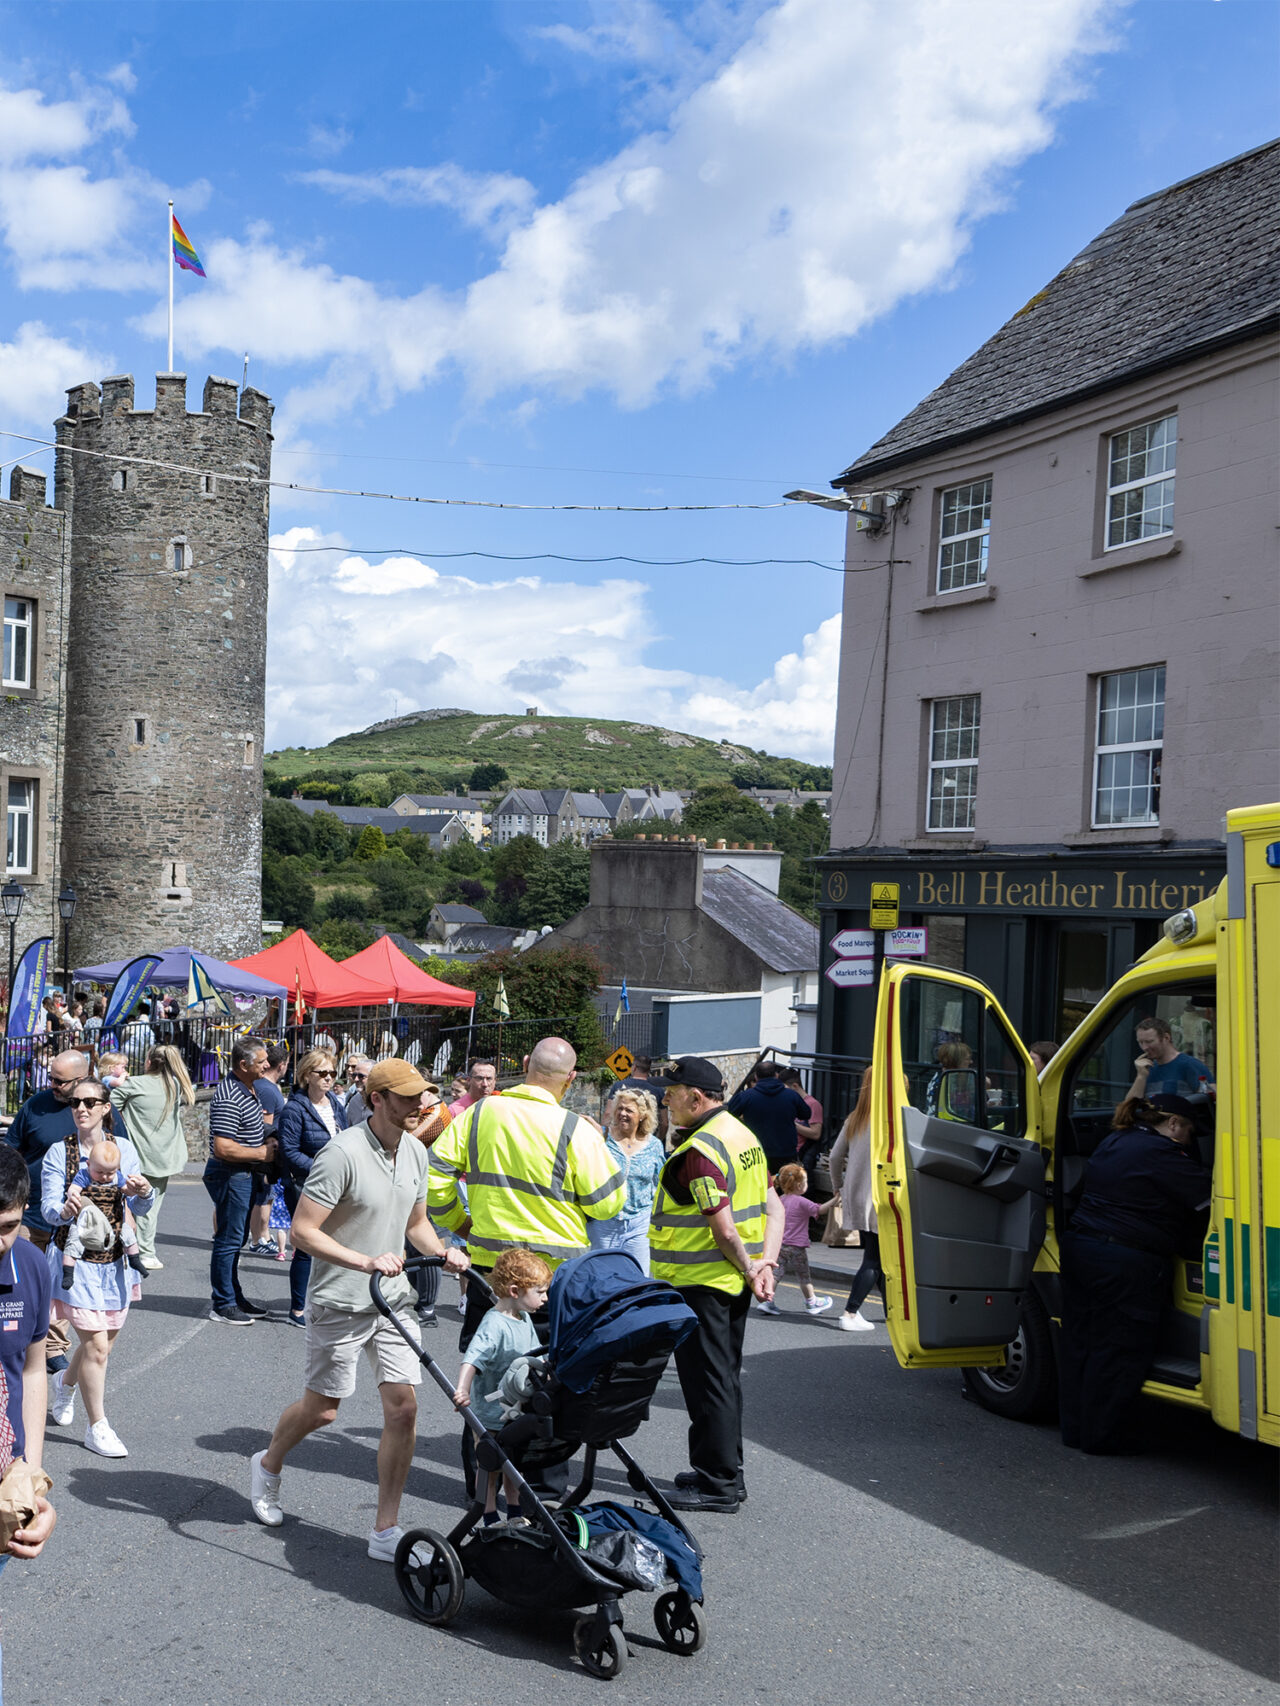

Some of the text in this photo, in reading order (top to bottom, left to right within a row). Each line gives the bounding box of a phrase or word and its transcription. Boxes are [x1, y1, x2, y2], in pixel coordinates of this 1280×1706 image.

[832, 873, 843, 899] 3
[916, 872, 965, 905] Bell
[977, 870, 1105, 908] Heather
[837, 939, 875, 948] Food Marqu
[835, 968, 874, 978] Market Squa
